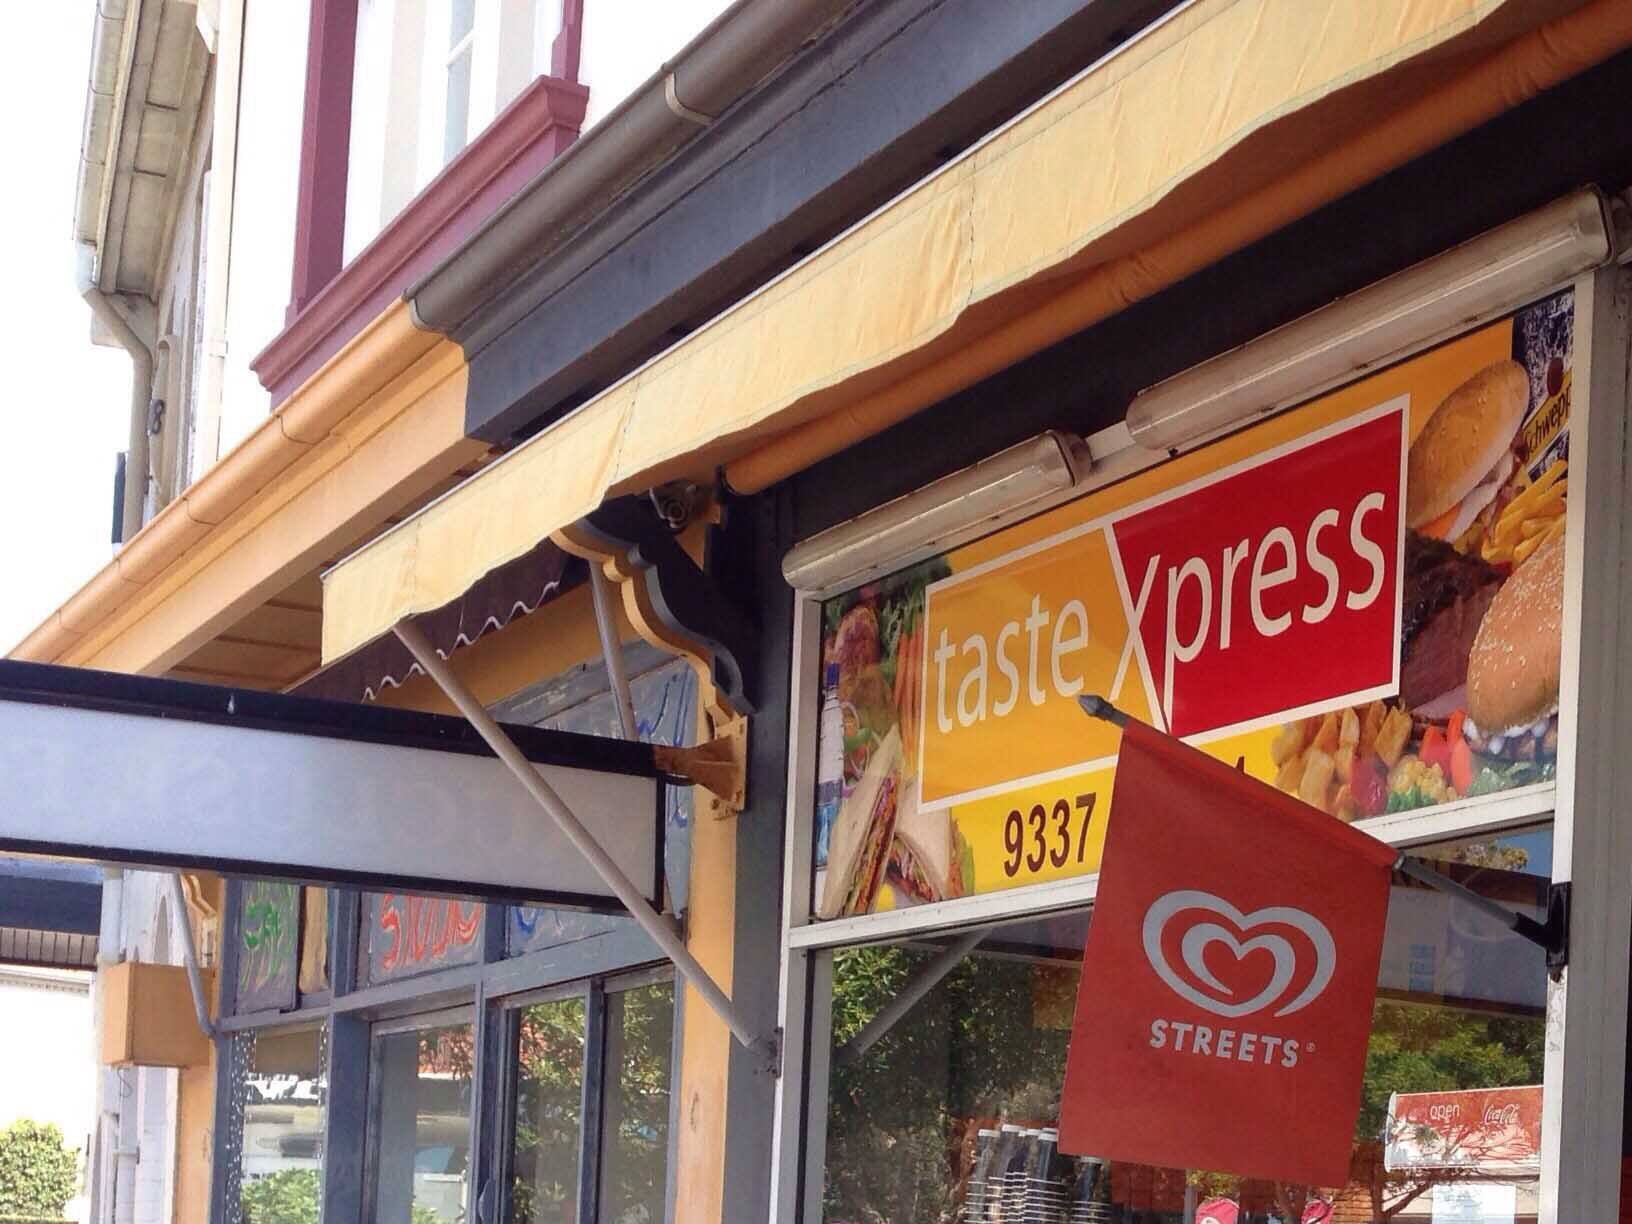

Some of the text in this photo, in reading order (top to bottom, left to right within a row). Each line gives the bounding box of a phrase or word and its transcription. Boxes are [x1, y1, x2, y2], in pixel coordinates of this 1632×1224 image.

[1003, 792, 1097, 878] 9337
[1148, 1018, 1299, 1069] STREETS
[1430, 1104, 1460, 1121] open
